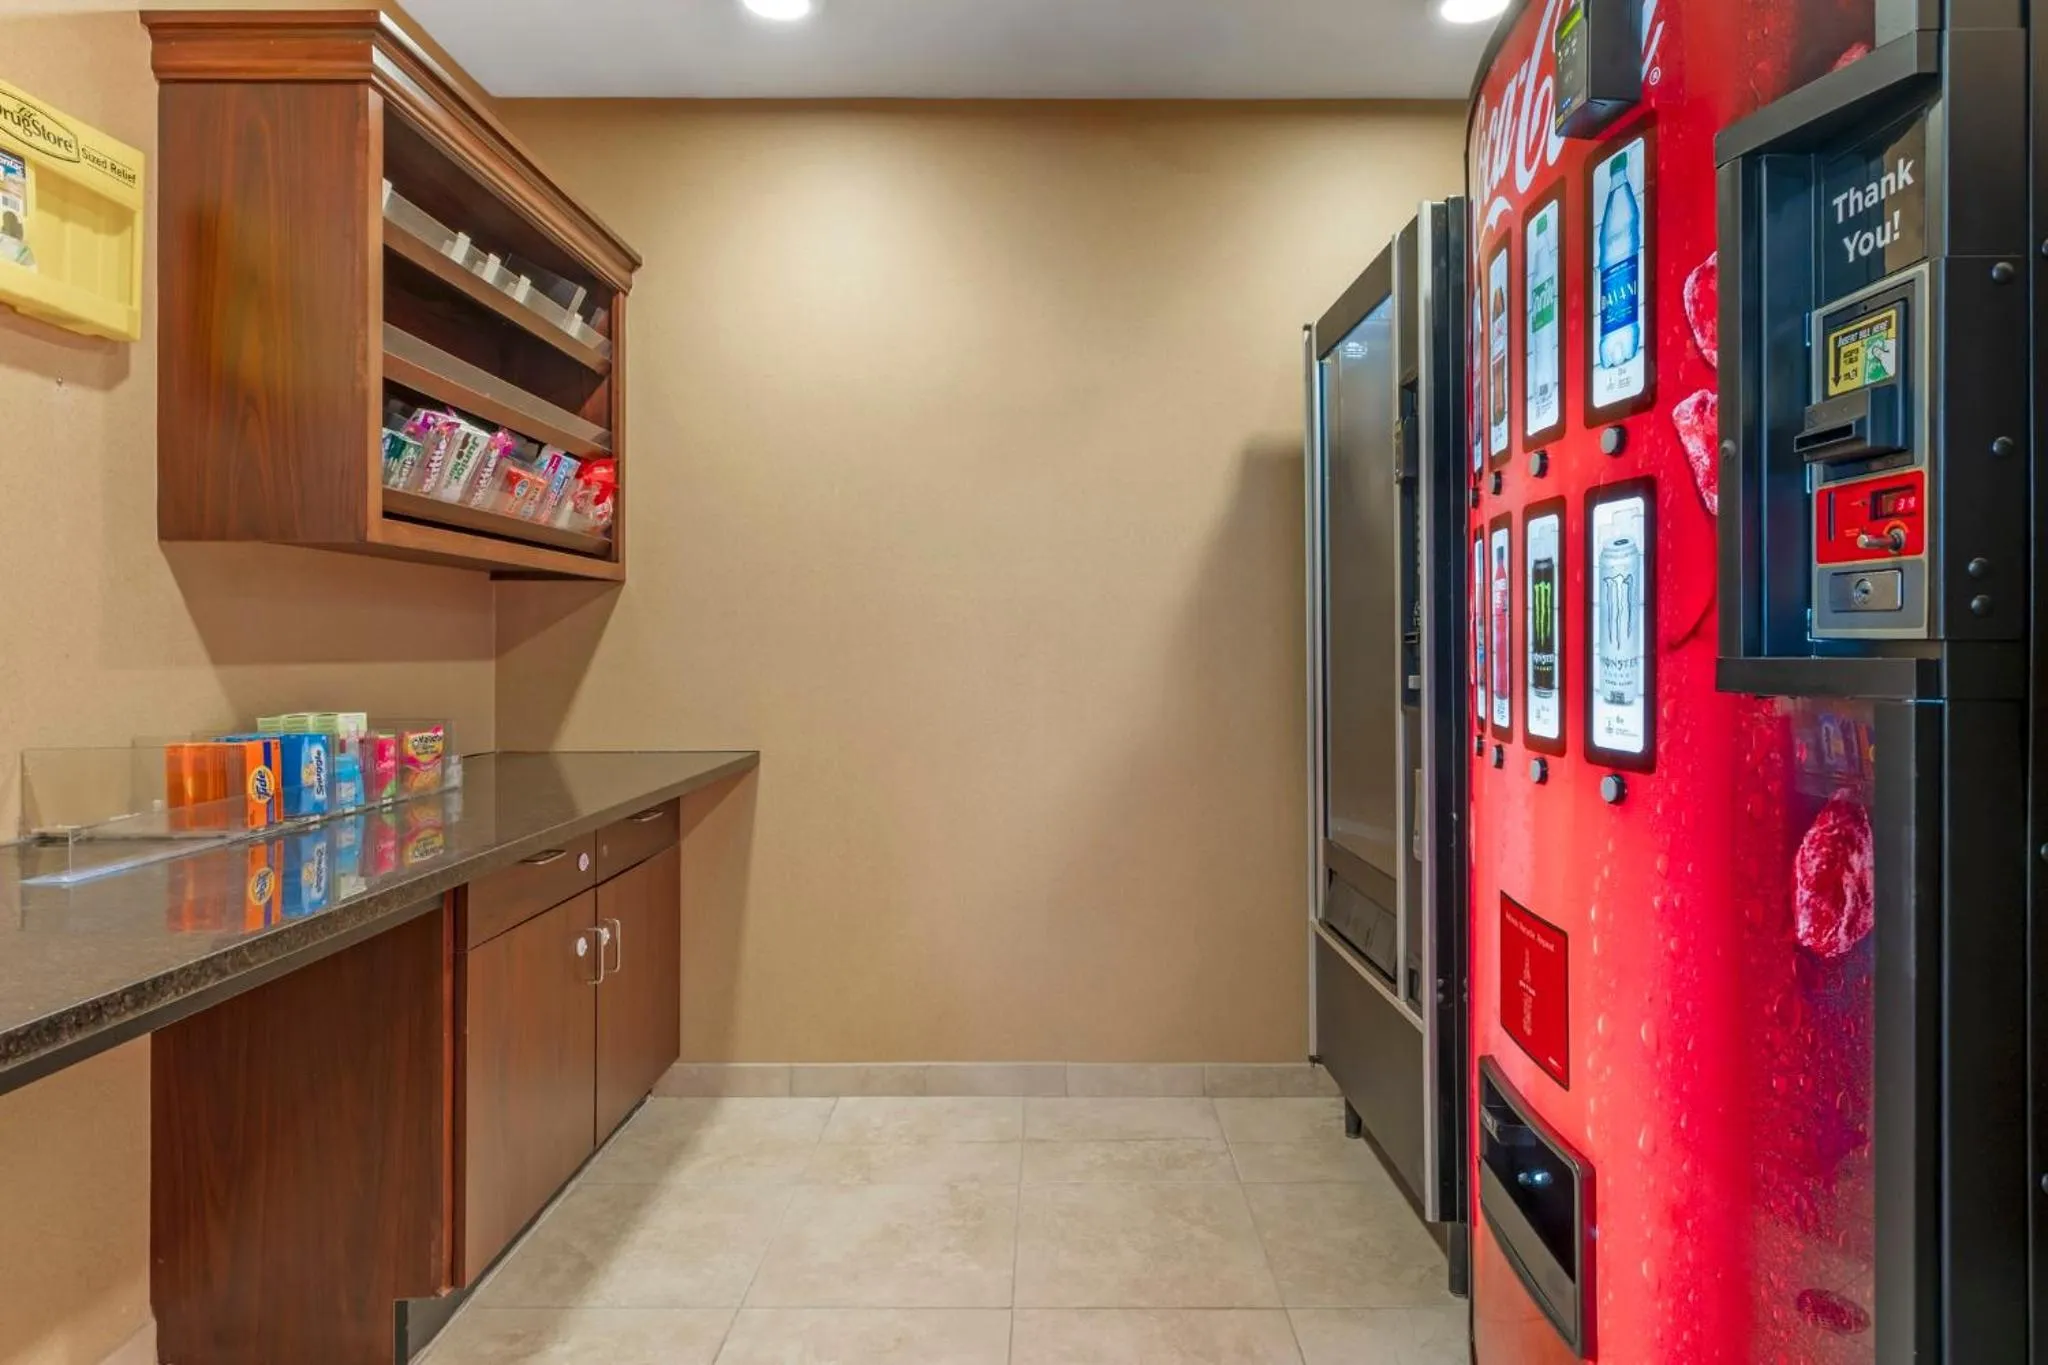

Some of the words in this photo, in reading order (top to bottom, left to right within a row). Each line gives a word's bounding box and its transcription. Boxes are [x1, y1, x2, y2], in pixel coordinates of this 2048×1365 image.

[81, 147, 107, 169] Sized
[110, 163, 136, 184] Relief
[1832, 157, 1914, 225] Thank
[1843, 208, 1900, 263] You!
[255, 769, 274, 800] Tide
[315, 749, 325, 796] Snuggle
